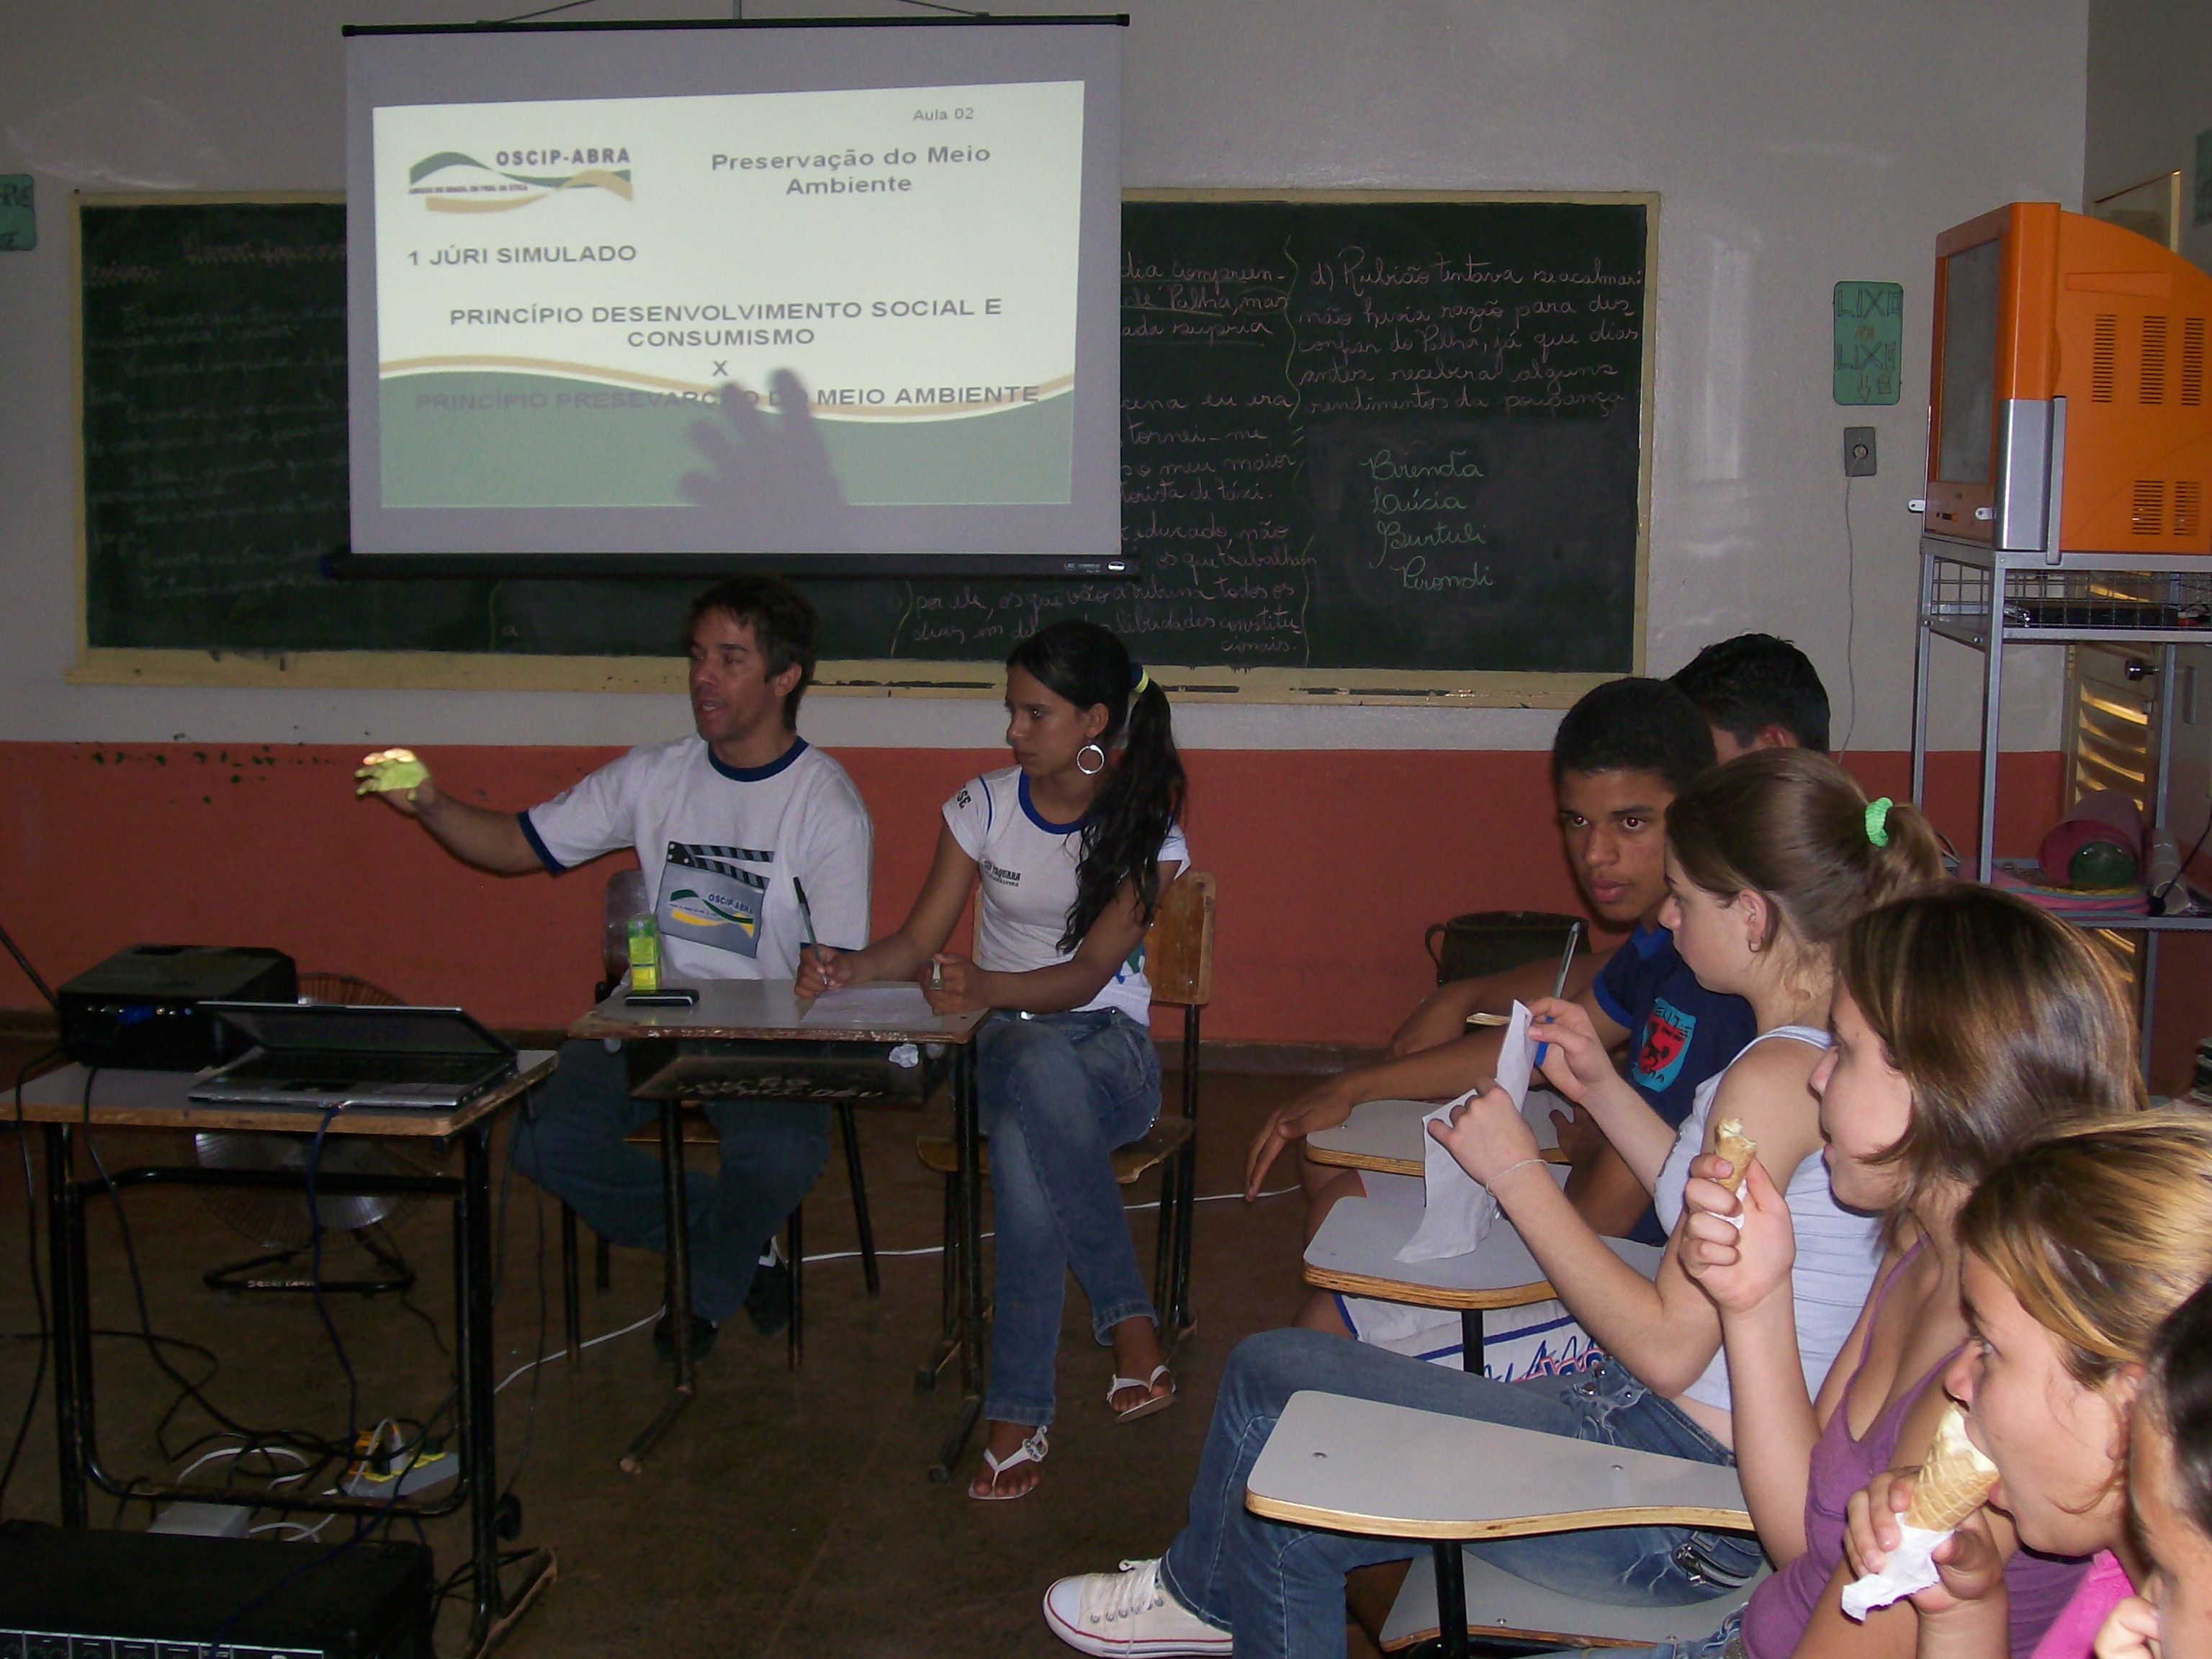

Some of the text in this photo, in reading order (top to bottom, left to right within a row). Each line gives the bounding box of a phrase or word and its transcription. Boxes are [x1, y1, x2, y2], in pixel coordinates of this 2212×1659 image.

[912, 107, 974, 121] Aula 02
[495, 148, 631, 166] OSCIP-ABRA
[711, 145, 992, 171] Preservação do Meio
[786, 175, 912, 195] Ambiente
[408, 245, 637, 266] 1 JÚRI SIMULADO
[449, 298, 1002, 325] PRINCÍPIO DESENVOLVIMENTO SOCIAL E
[626, 328, 815, 348] CONSUMISMO
[1533, 328, 1581, 364] que
[712, 360, 729, 377] X
[415, 388, 548, 410] PRINCÍPIO
[555, 390, 759, 410] PRESEVARÇO
[817, 388, 886, 405] MEIO
[894, 385, 1040, 405] AMBIENTE
